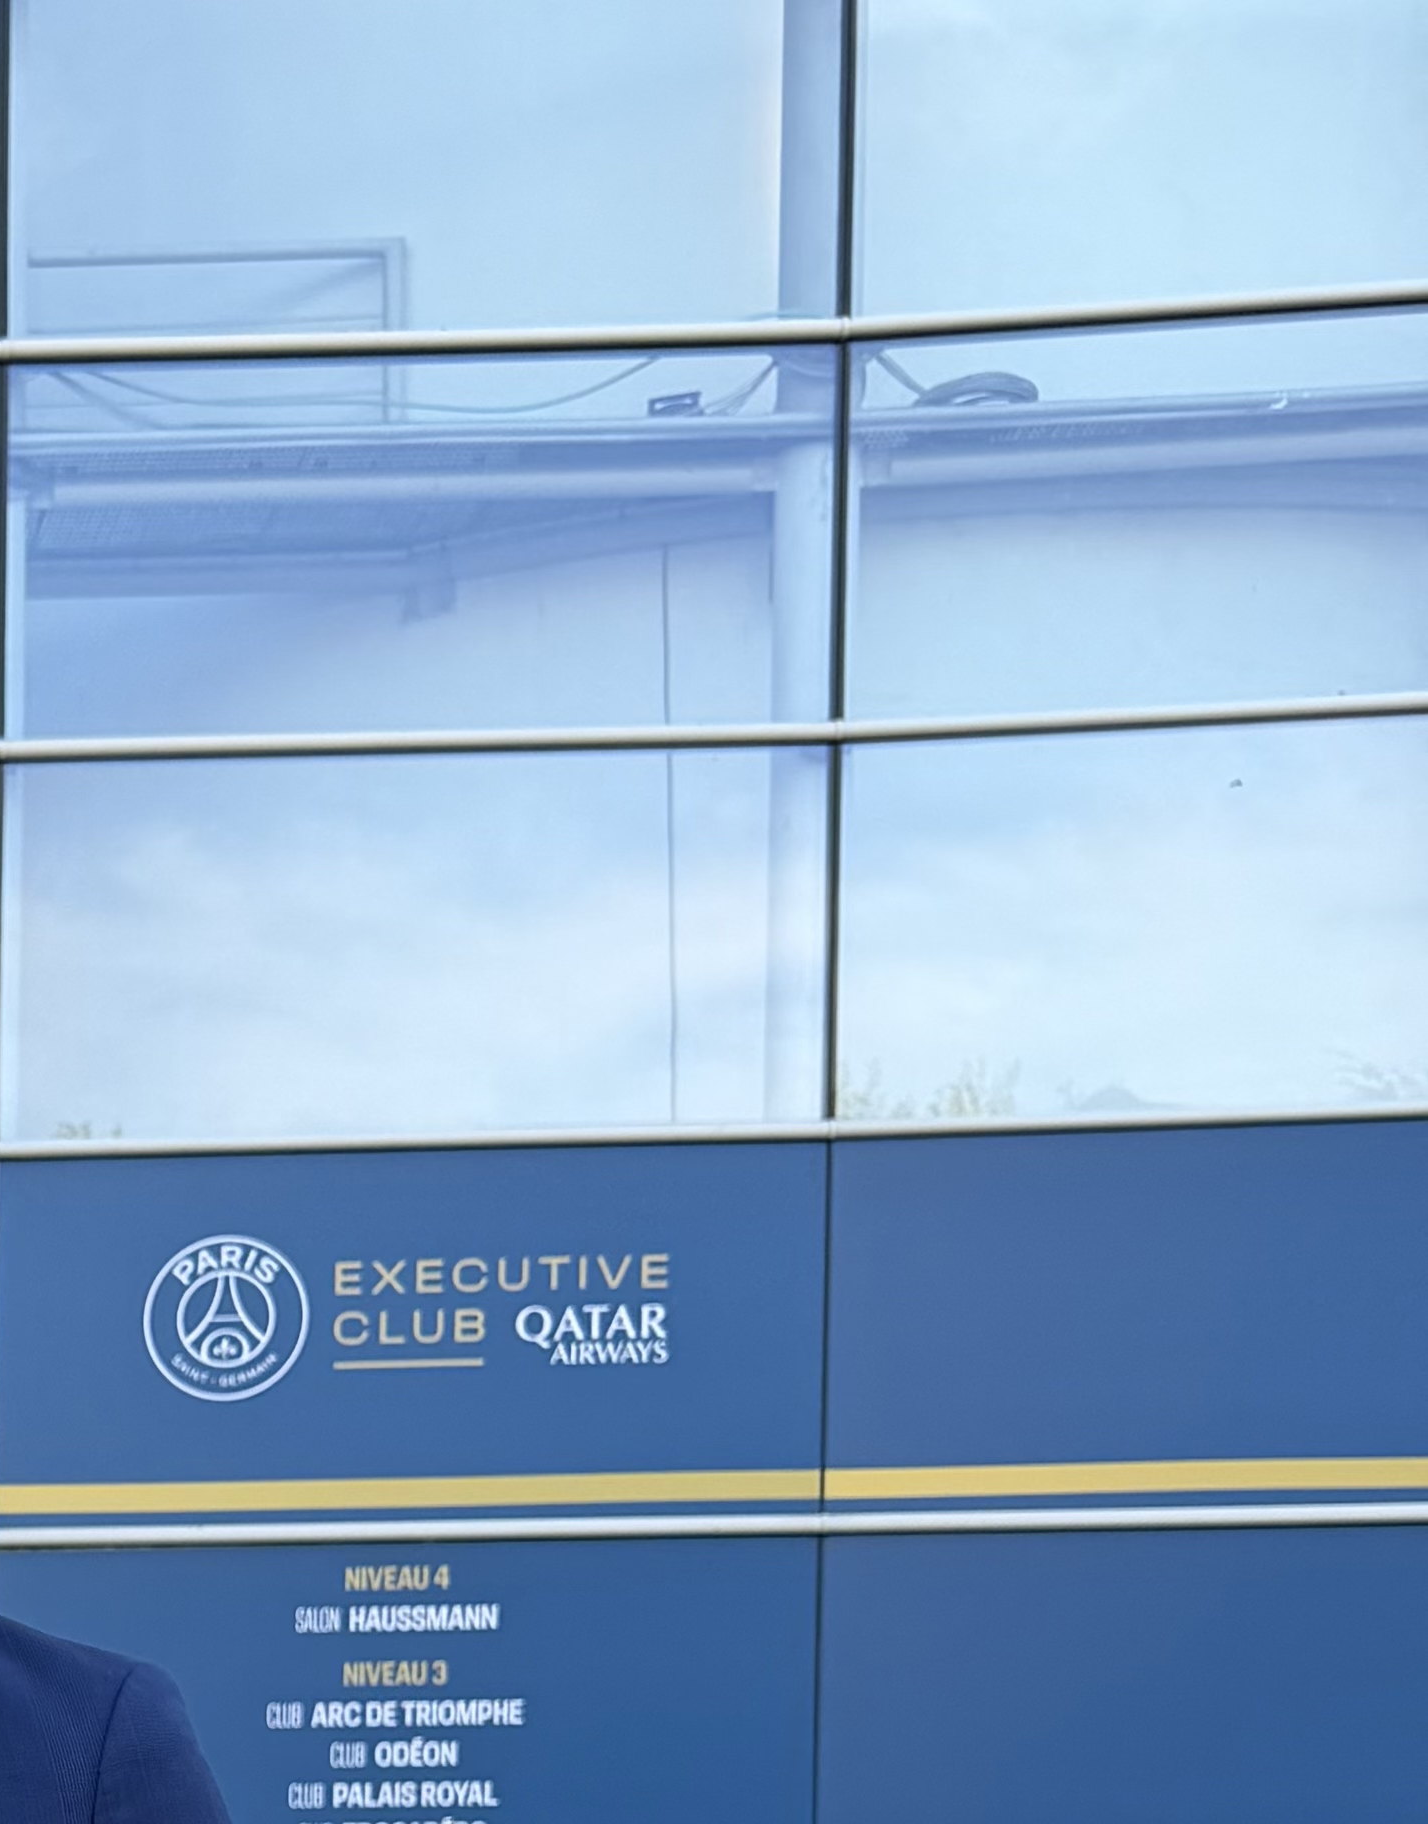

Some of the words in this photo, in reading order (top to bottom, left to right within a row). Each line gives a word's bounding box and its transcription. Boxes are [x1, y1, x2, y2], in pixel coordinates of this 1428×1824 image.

[171, 1244, 281, 1286] PARIS
[333, 1252, 670, 1296] EXECUTIVE
[333, 1307, 486, 1346] CLUB
[514, 1302, 667, 1349] QATAR
[549, 1340, 670, 1366] AIRWAYS
[345, 1565, 430, 1591] NIVEAU
[433, 1564, 451, 1590] 4
[295, 1606, 341, 1633] SALON
[349, 1604, 500, 1632] HAUSSMANN
[343, 1661, 428, 1687] NIVEAU
[431, 1660, 448, 1686] 3
[266, 1702, 305, 1729] CLUB
[311, 1701, 362, 1729] ARC
[366, 1701, 397, 1728] DE
[401, 1699, 526, 1727] TRIOMPHE
[330, 1741, 368, 1769] CLUB
[374, 1736, 460, 1768] ODÉON
[288, 1782, 325, 1809] CLUB
[332, 1781, 417, 1808] PALAIS
[421, 1780, 499, 1807] ROYAL
